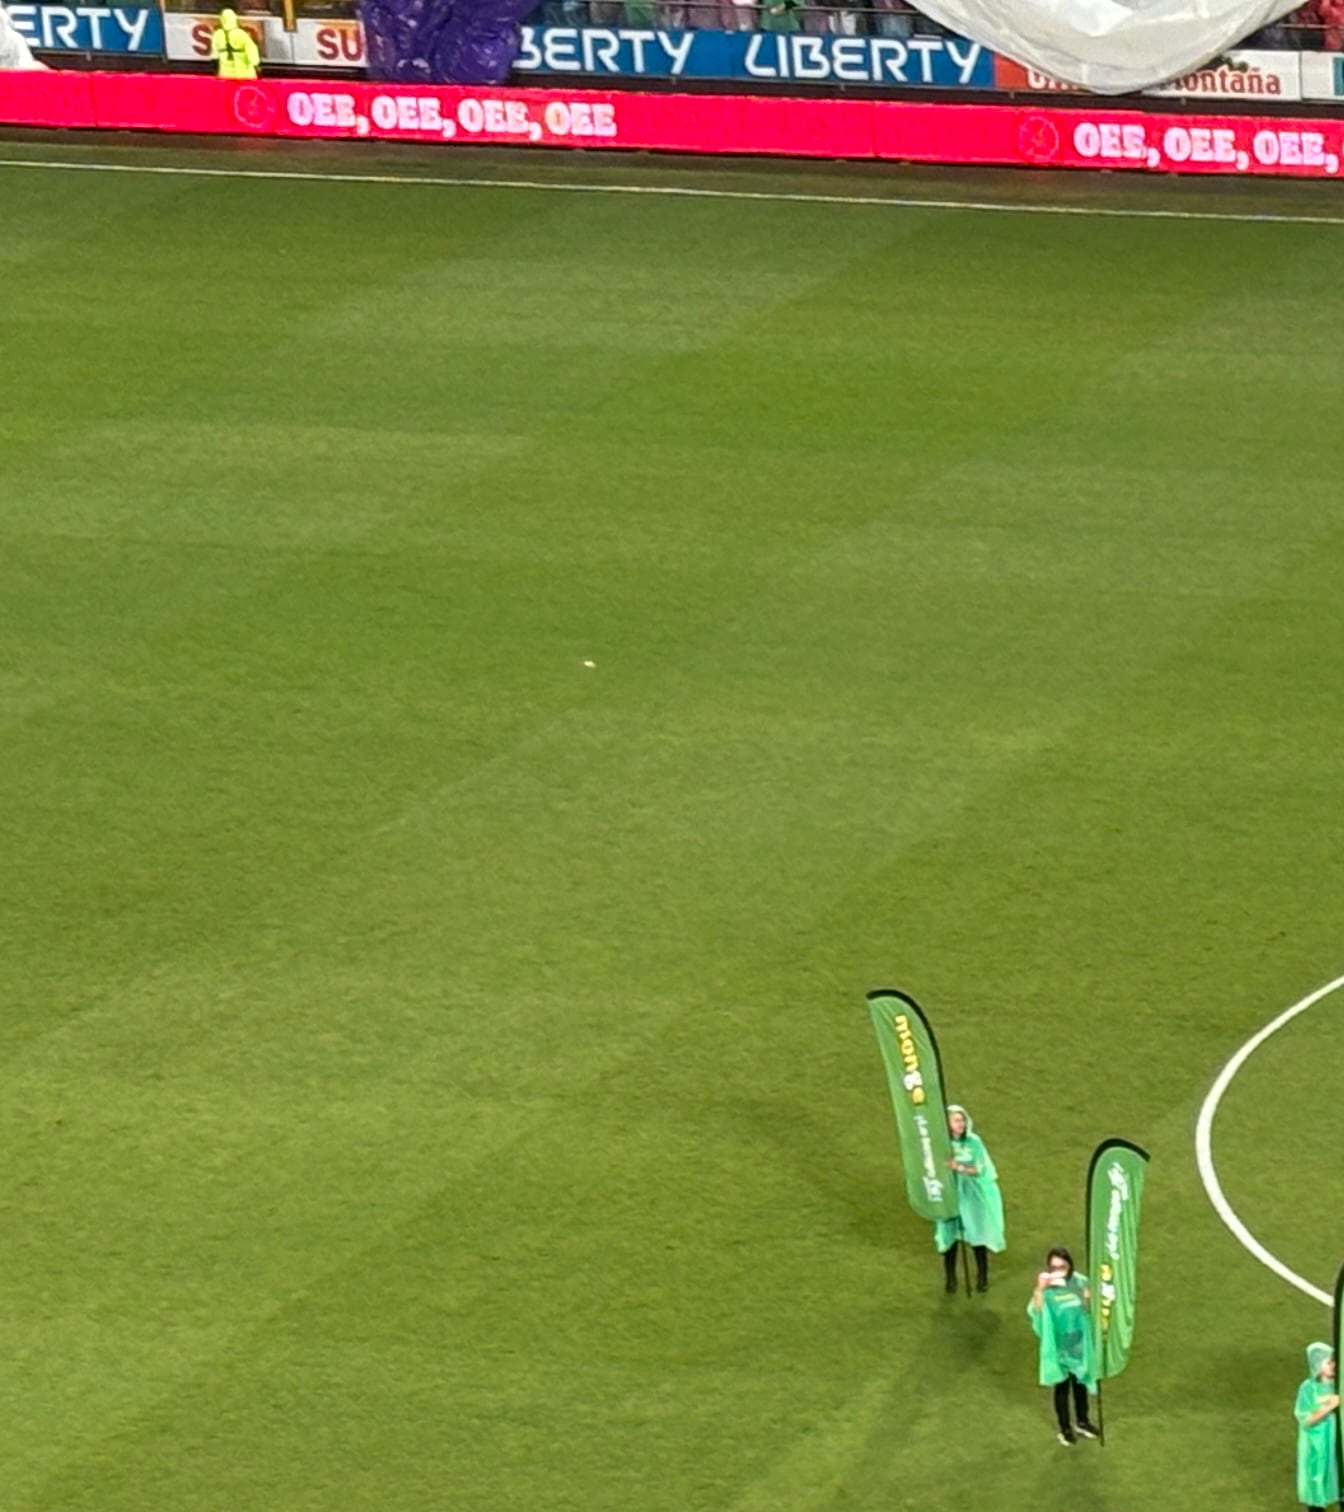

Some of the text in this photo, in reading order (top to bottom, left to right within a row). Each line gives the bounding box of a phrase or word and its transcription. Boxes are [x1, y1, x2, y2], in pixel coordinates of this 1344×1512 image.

[744, 33, 982, 84] LIBERTY
[287, 91, 618, 142] OEE, OEE, OEE, OEE
[1073, 121, 1160, 166] OEE,
[1163, 125, 1249, 170] OEE,
[1252, 129, 1339, 174] OEE,
[895, 1015, 926, 1105] monge
